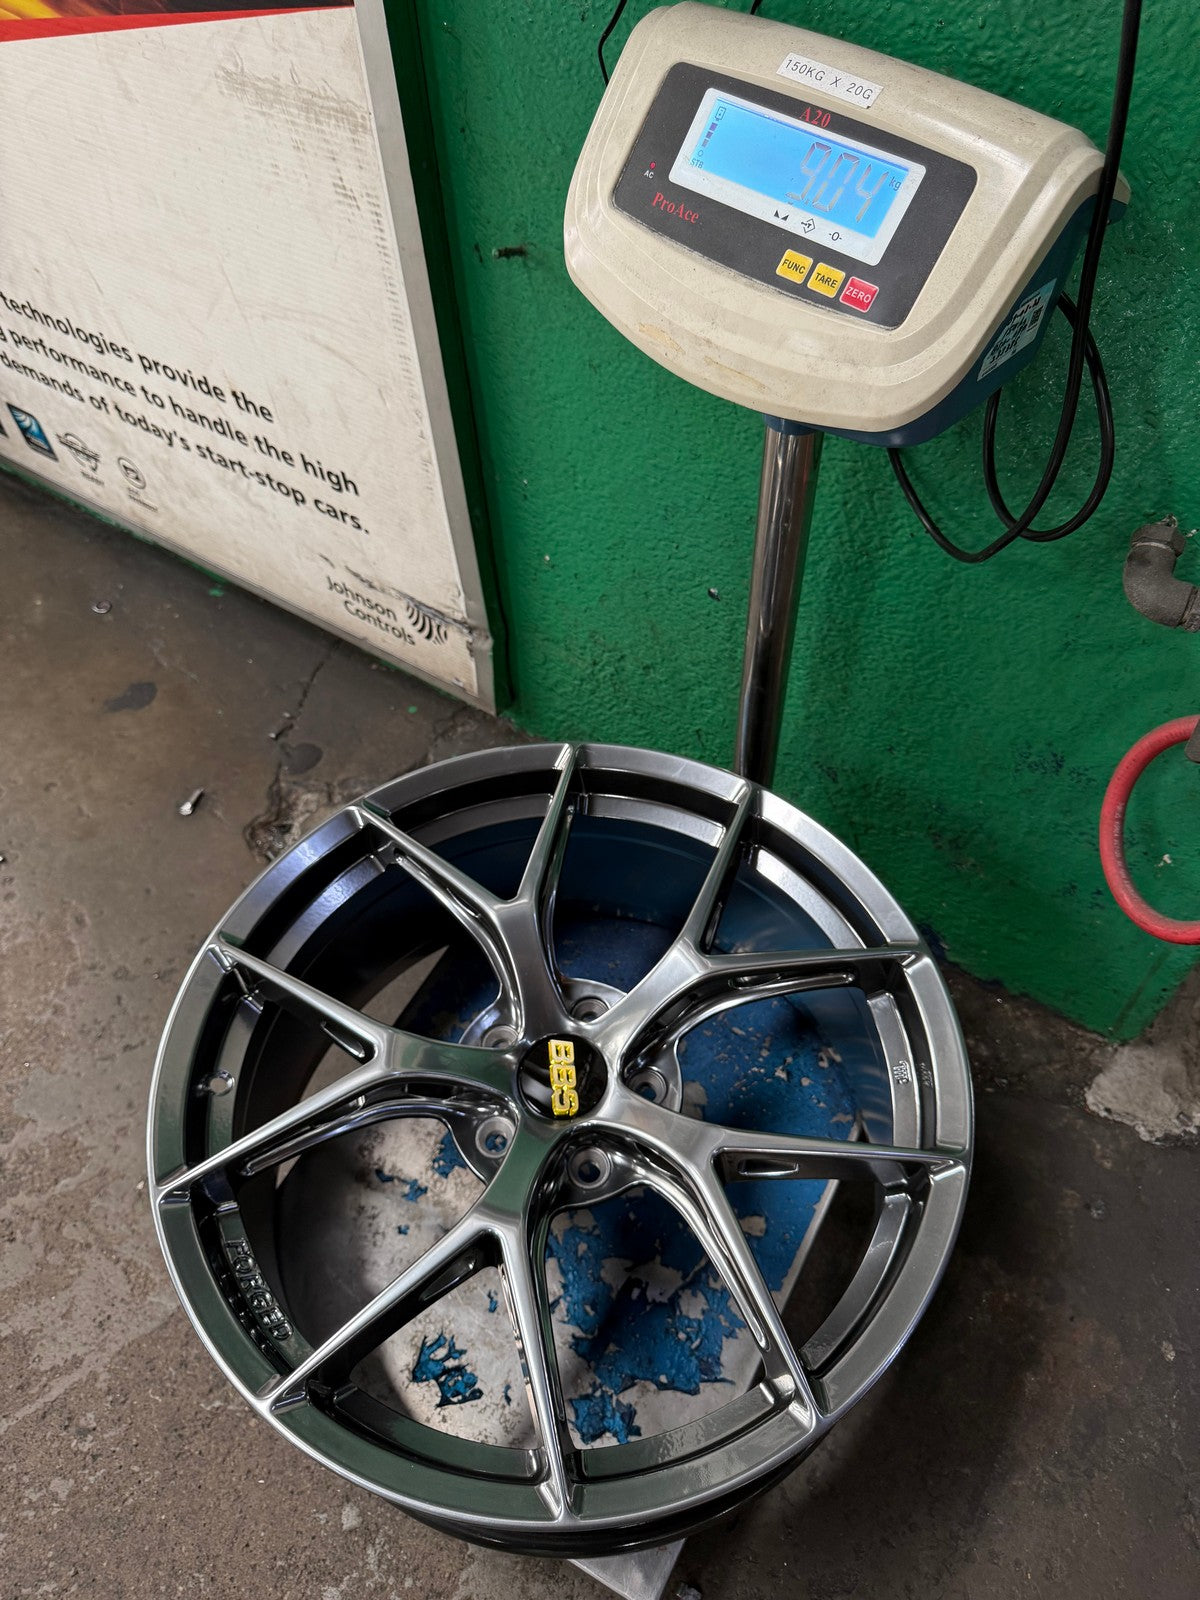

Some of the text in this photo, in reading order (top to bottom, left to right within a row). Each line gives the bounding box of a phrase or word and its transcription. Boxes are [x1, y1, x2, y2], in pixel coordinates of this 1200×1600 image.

[784, 58, 874, 101] 150KG X 20G
[799, 106, 832, 129] A20
[643, 169, 655, 179] AC
[690, 157, 705, 169] STB
[888, 175, 902, 192] kg
[651, 191, 700, 225] ProAce
[781, 257, 807, 276] FUNC
[814, 271, 839, 290] TARE
[845, 285, 872, 305] ZERO
[0, 291, 275, 424] technologies provide the
[8, 328, 361, 497] performance to handle the high
[0, 350, 86, 404] demands
[88, 395, 111, 415] of
[113, 403, 192, 452] today's
[195, 442, 307, 506] start-stop
[313, 497, 371, 535] cars.
[325, 574, 398, 623] Johnson
[343, 599, 416, 646] Controls
[547, 1039, 580, 1117] BBS
[223, 1238, 296, 1342] FORGED
